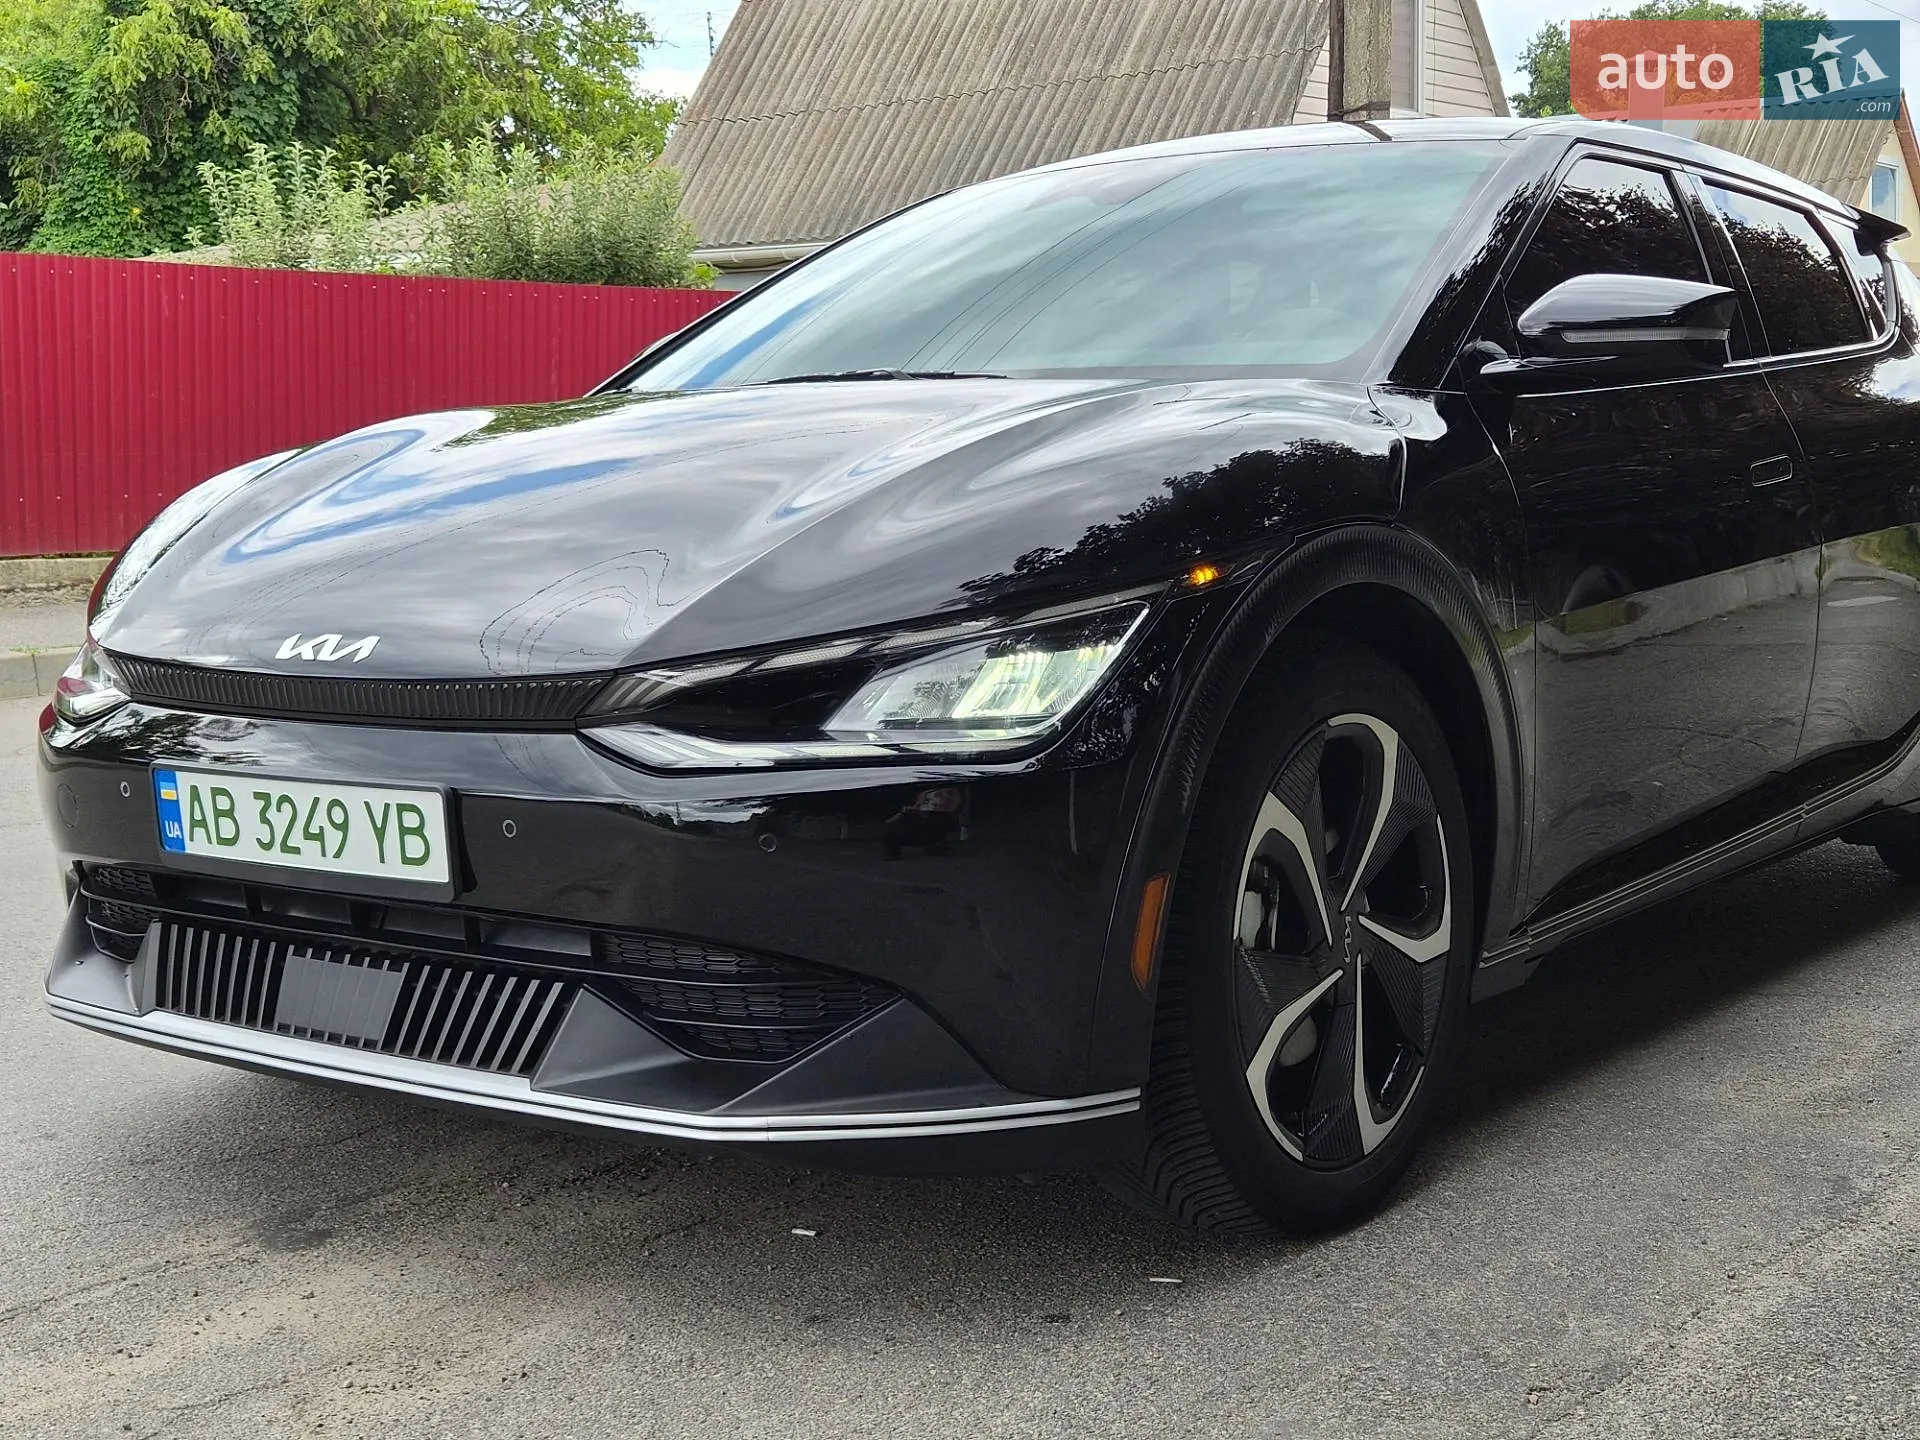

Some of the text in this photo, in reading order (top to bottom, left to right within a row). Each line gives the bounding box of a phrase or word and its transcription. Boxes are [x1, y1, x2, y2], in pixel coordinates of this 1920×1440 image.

[275, 633, 380, 663] KIA
[165, 821, 182, 838] UA
[188, 784, 431, 866] AB 3249 YB
